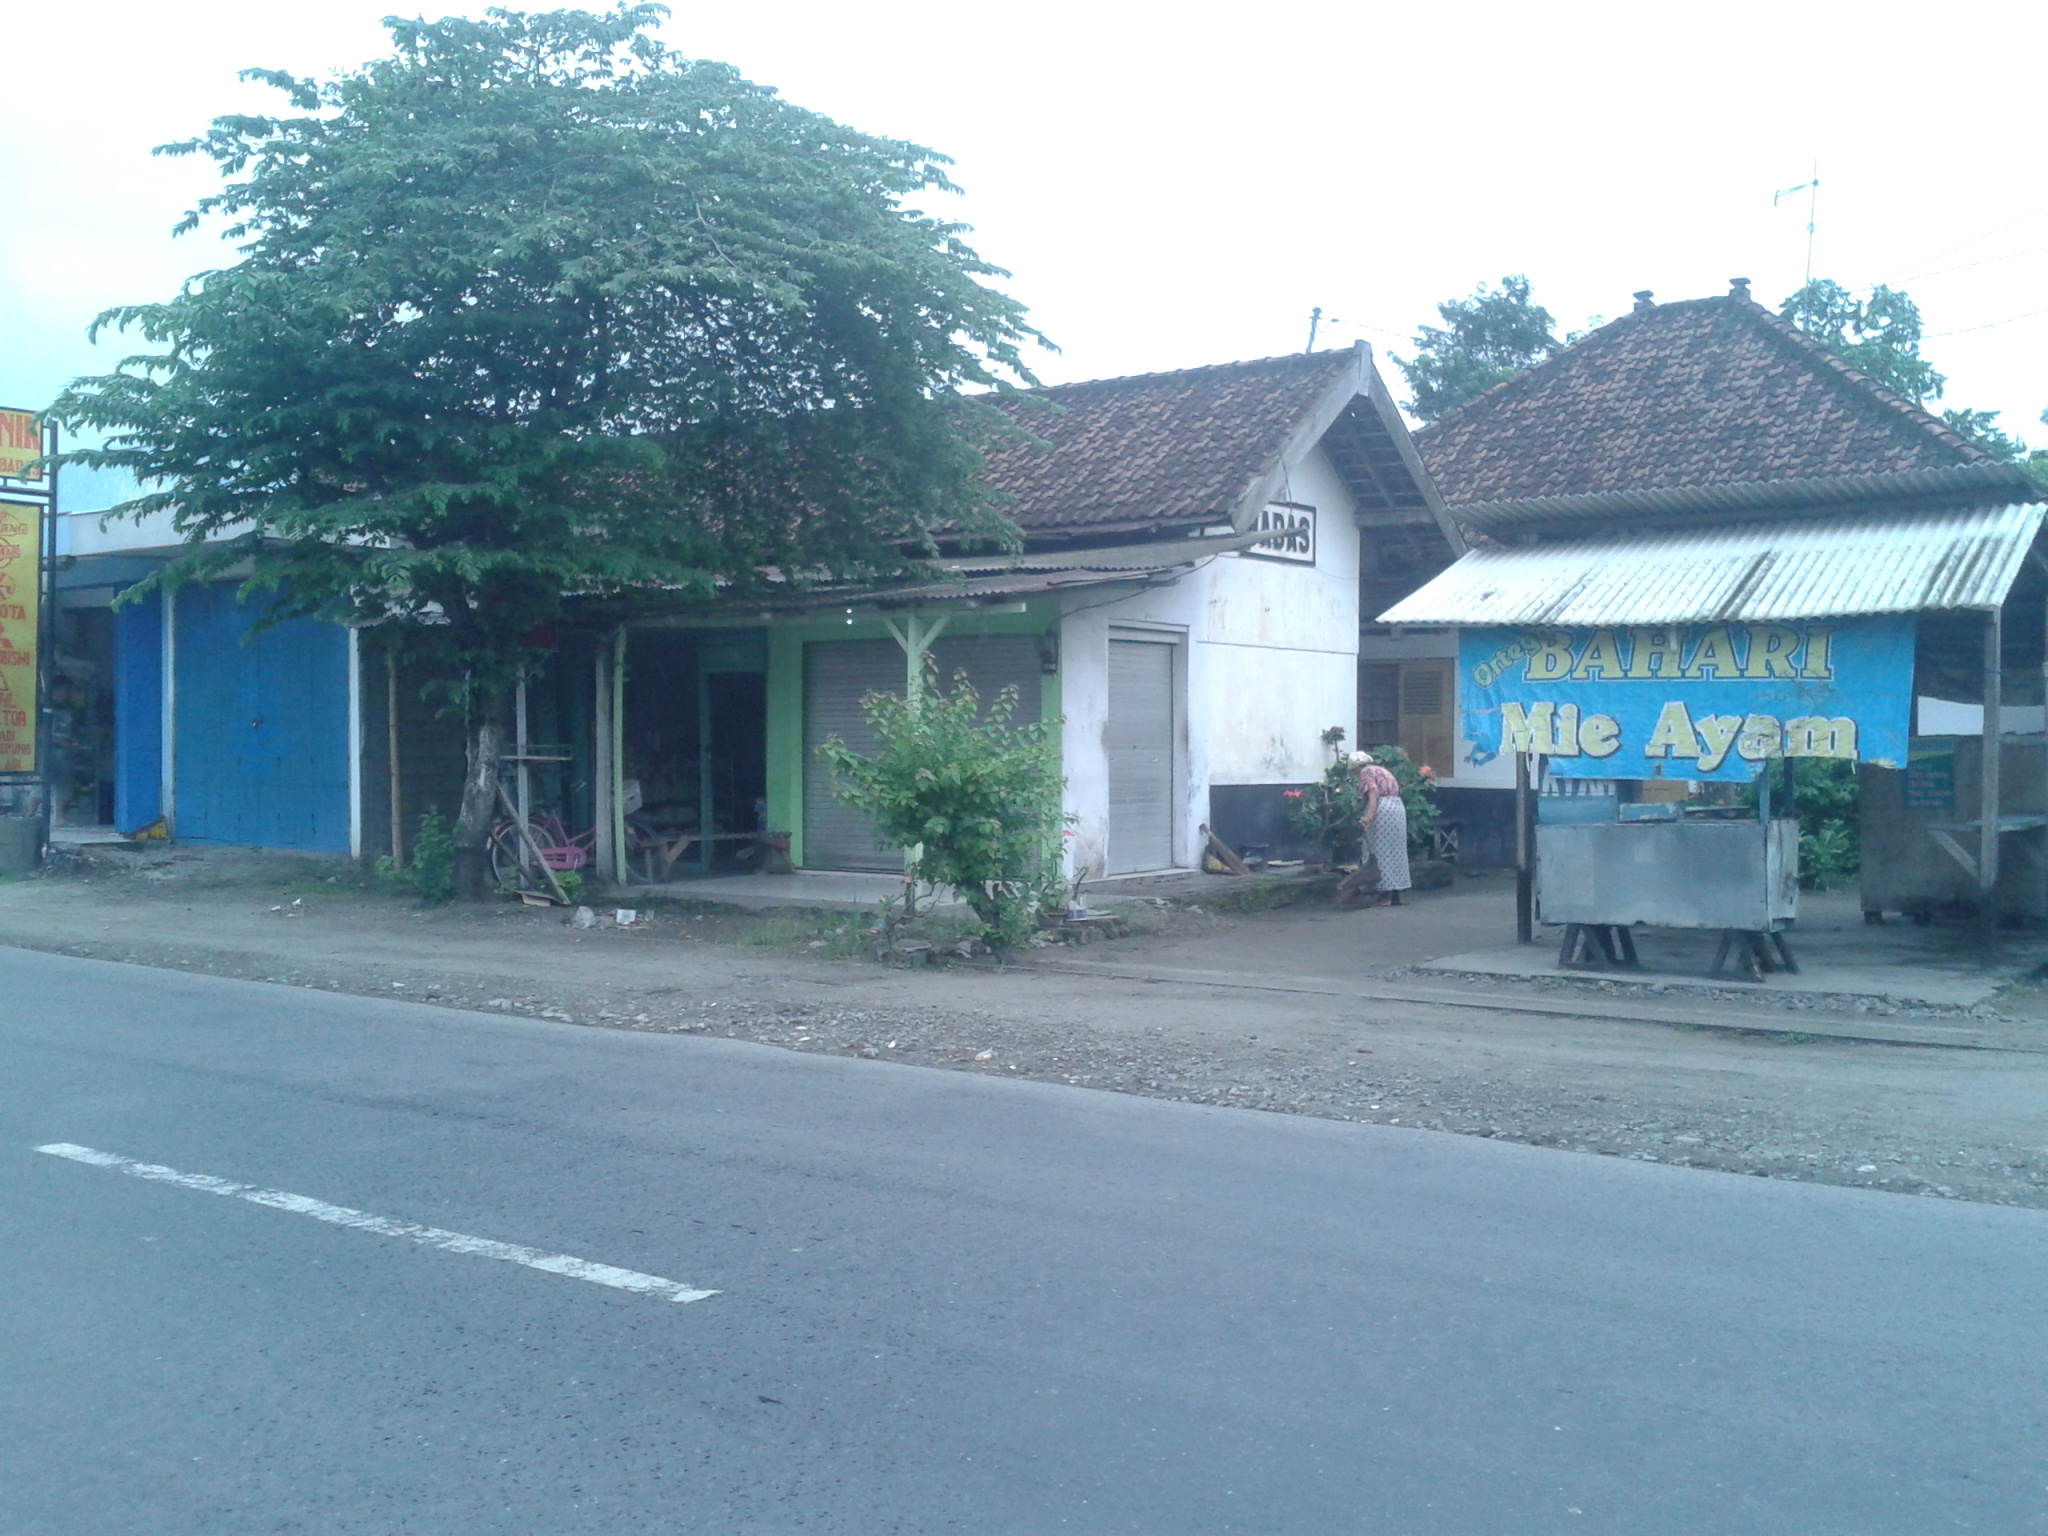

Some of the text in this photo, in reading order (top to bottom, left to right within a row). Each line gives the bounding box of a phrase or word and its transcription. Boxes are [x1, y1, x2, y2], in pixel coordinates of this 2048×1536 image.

[1522, 626, 1835, 682] BAHARI
[1500, 701, 1859, 772] Mie Ayam
